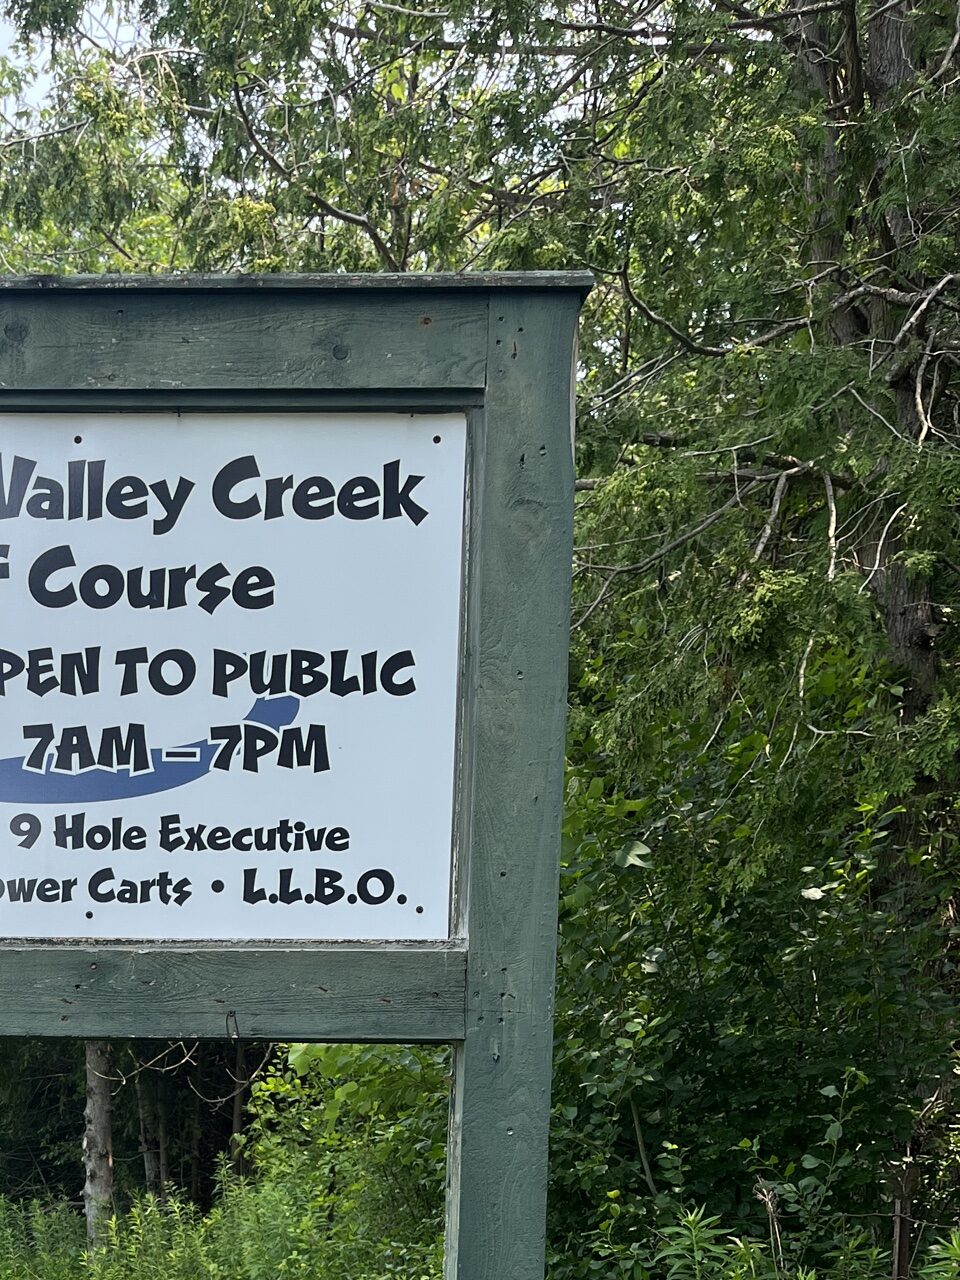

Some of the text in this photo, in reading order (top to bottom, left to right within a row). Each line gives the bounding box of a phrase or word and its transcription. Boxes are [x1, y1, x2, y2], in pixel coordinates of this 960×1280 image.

[212, 455, 428, 526] Creek
[29, 545, 275, 615] Course
[115, 647, 196, 696] TO
[213, 649, 416, 698] PUBLIC
[23, 723, 152, 773] 7AM
[210, 724, 330, 773] 7PM
[10, 812, 349, 853] 9 Hole Executive
[88, 868, 192, 906] Carts
[243, 868, 407, 905] L.L.B.O.
